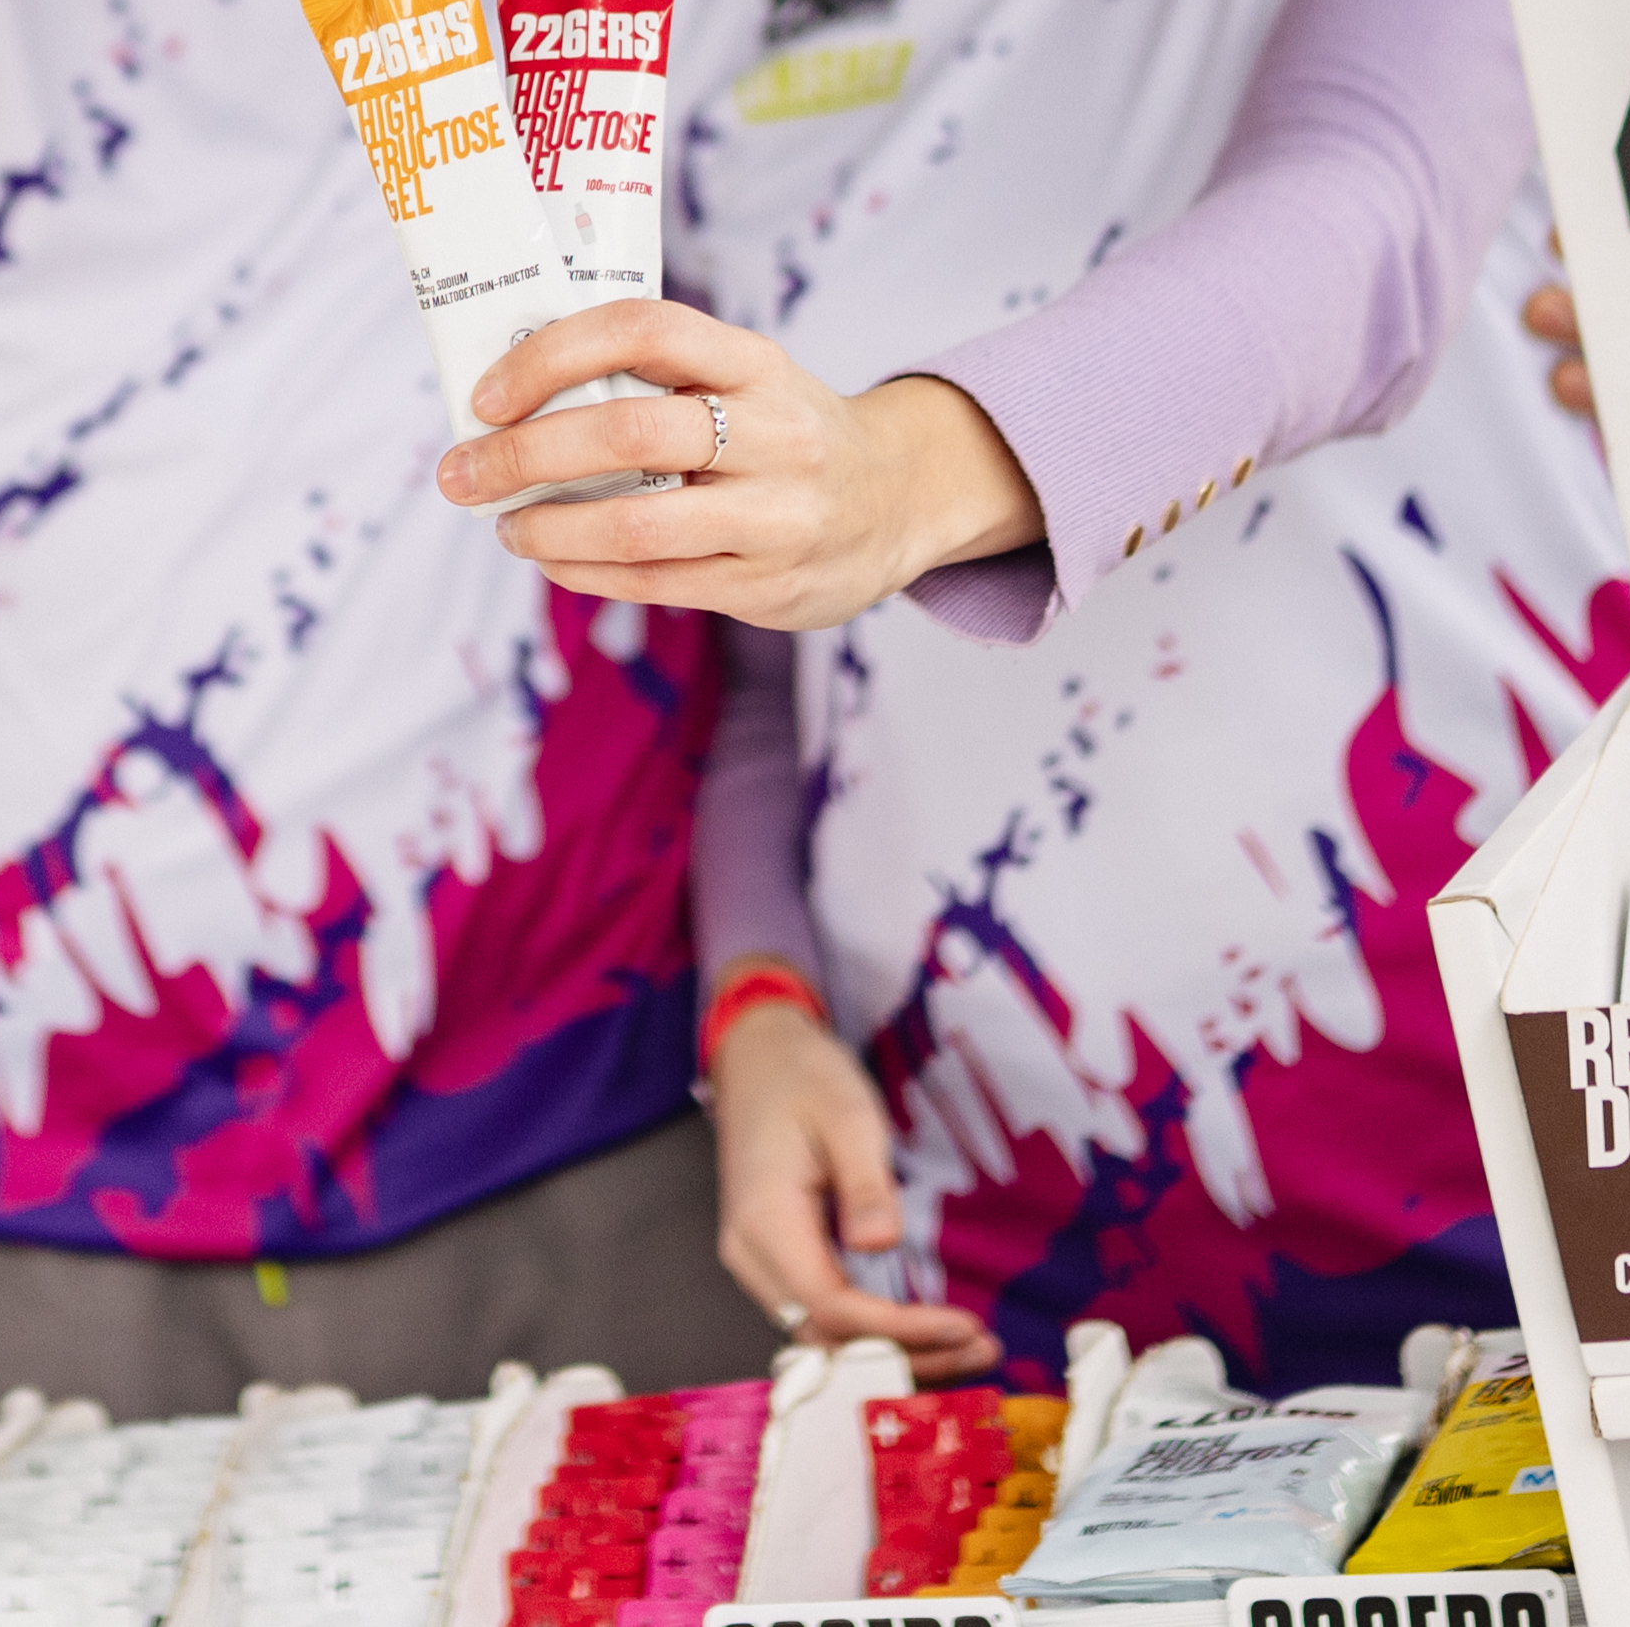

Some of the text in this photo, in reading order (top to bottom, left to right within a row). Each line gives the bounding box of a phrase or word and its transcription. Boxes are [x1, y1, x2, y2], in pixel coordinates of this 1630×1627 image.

[333, 0, 479, 95] 226ERS
[509, 9, 662, 63] 226ERS
[356, 83, 425, 148] HIGH
[512, 69, 589, 116] HIGH
[369, 102, 505, 186] FRUCTOSE
[514, 110, 657, 156] FRUCTOSE
[524, 151, 564, 193] EL
[585, 179, 653, 196] 100mg CAFFEINE
[381, 171, 433, 224] GEL
[420, 266, 431, 279] CH
[432, 263, 541, 308] MALTODEXTRIN-FRUCTOSE
[436, 271, 469, 291] SODIUM
[567, 270, 645, 284] XTRINE-FRUCTOSE
